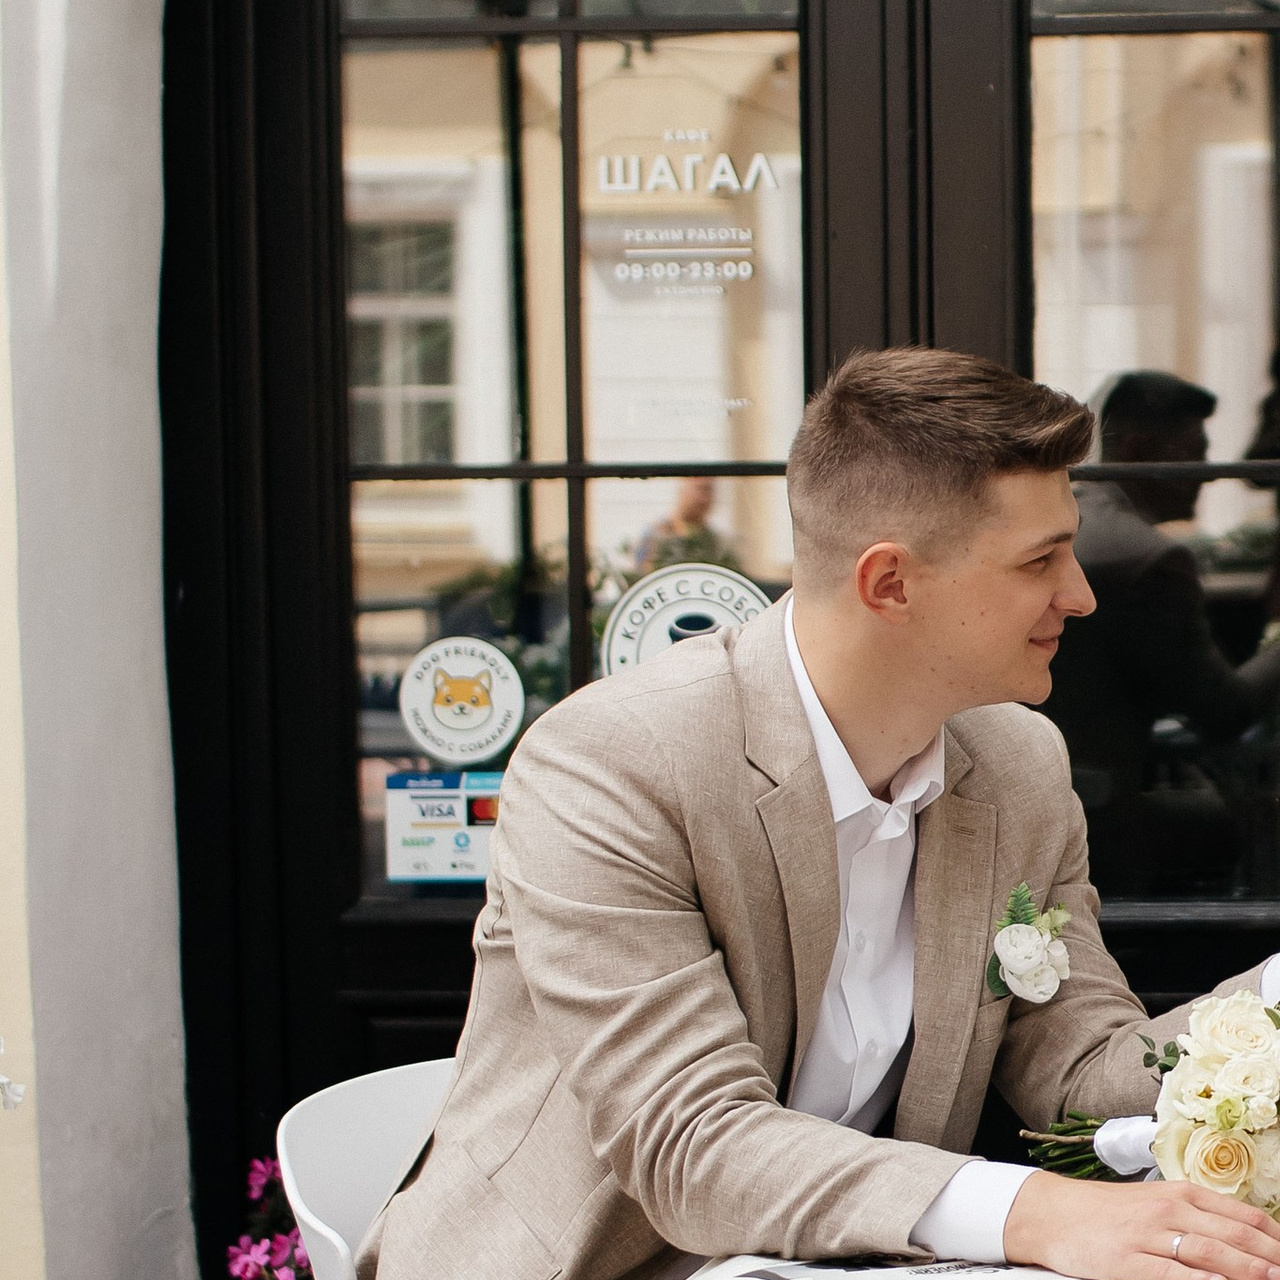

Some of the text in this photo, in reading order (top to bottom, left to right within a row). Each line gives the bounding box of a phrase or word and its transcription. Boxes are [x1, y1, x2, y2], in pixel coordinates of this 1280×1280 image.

[598, 152, 779, 193] ШАГАЛ
[624, 227, 753, 242] РЕЖИМ РАБОТЫ
[621, 587, 668, 641] КОФЕ
[418, 803, 457, 818] VISA
